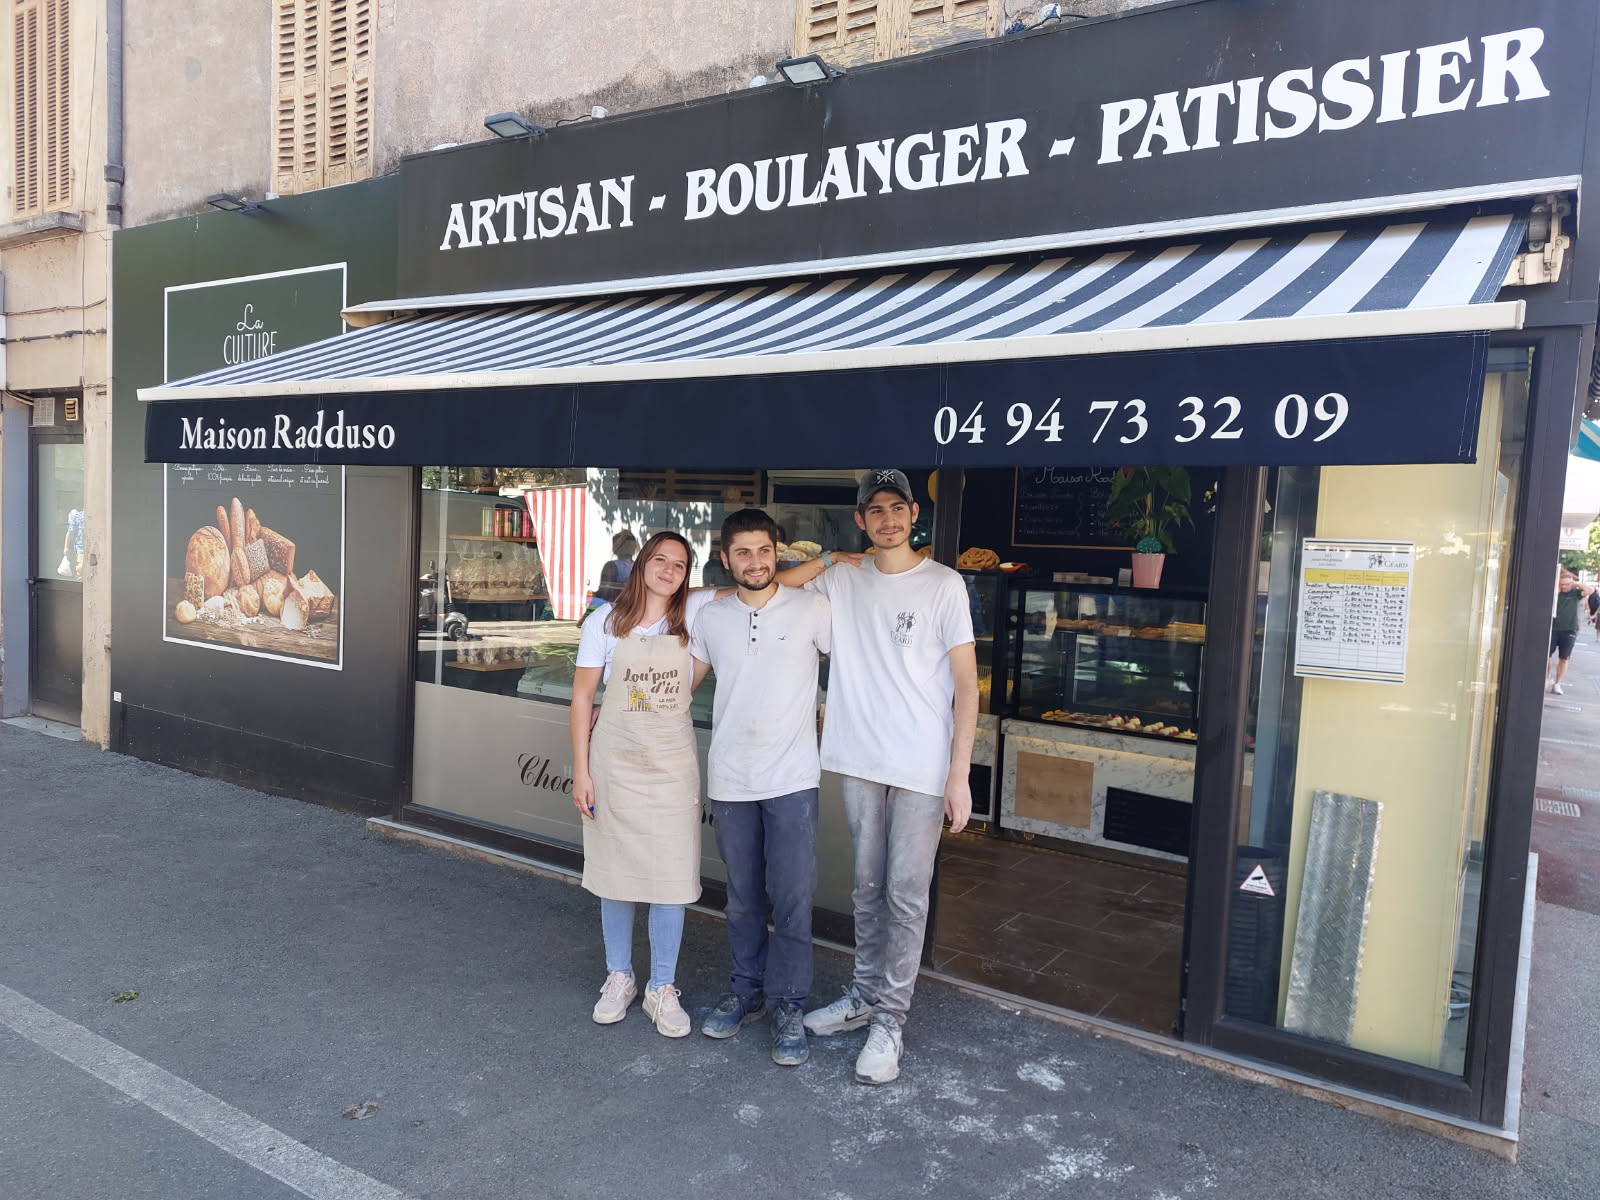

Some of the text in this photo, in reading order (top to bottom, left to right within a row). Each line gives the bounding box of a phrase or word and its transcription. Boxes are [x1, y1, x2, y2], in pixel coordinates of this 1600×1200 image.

[440, 175, 634, 250] ARTISAN
[685, 119, 1029, 220] BOULANGER
[1098, 27, 1550, 164] PATISSIER
[237, 303, 263, 331] La
[179, 409, 395, 450] Maison Radduso
[934, 392, 1349, 446] 04 94 73 32 09
[1035, 466, 1083, 484] Maison
[650, 681, 680, 694] d'ici
